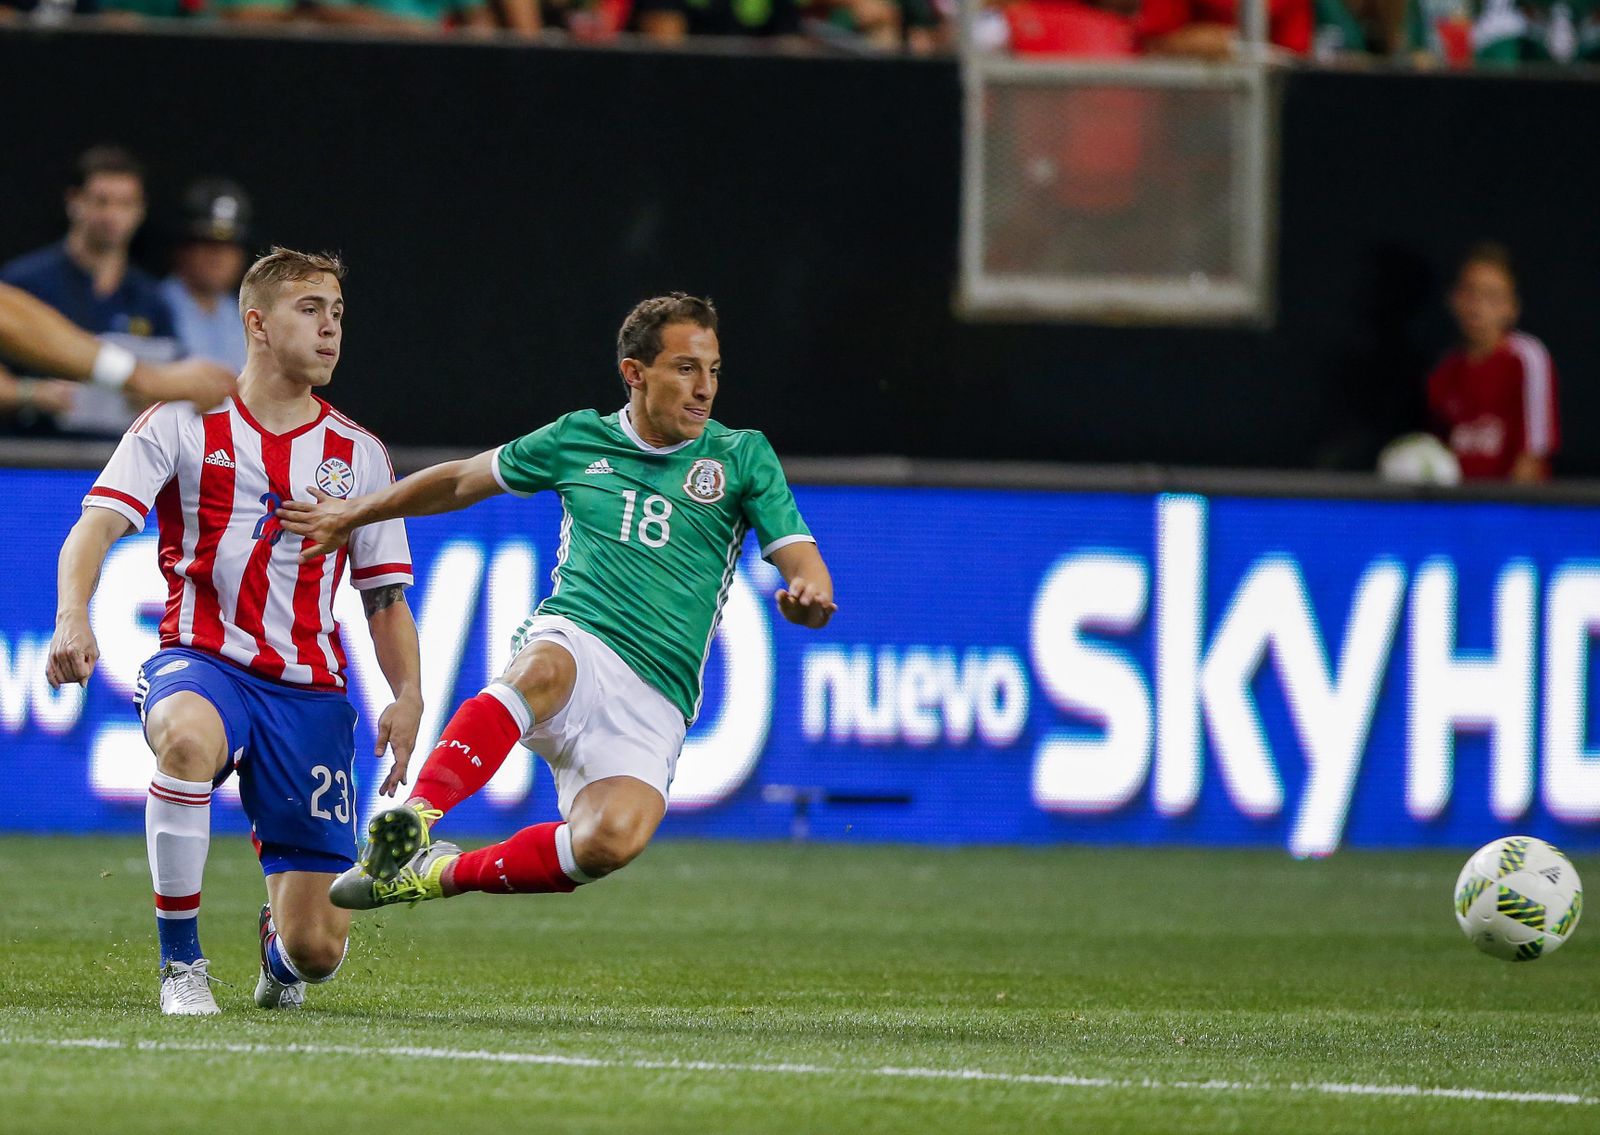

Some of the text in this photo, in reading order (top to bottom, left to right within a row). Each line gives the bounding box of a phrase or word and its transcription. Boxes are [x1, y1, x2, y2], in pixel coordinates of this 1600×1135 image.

[205, 456, 236, 469] adidas
[251, 492, 285, 547] 2
[620, 490, 673, 548] 18
[801, 644, 1030, 746] nuevo
[310, 765, 350, 824] 23
